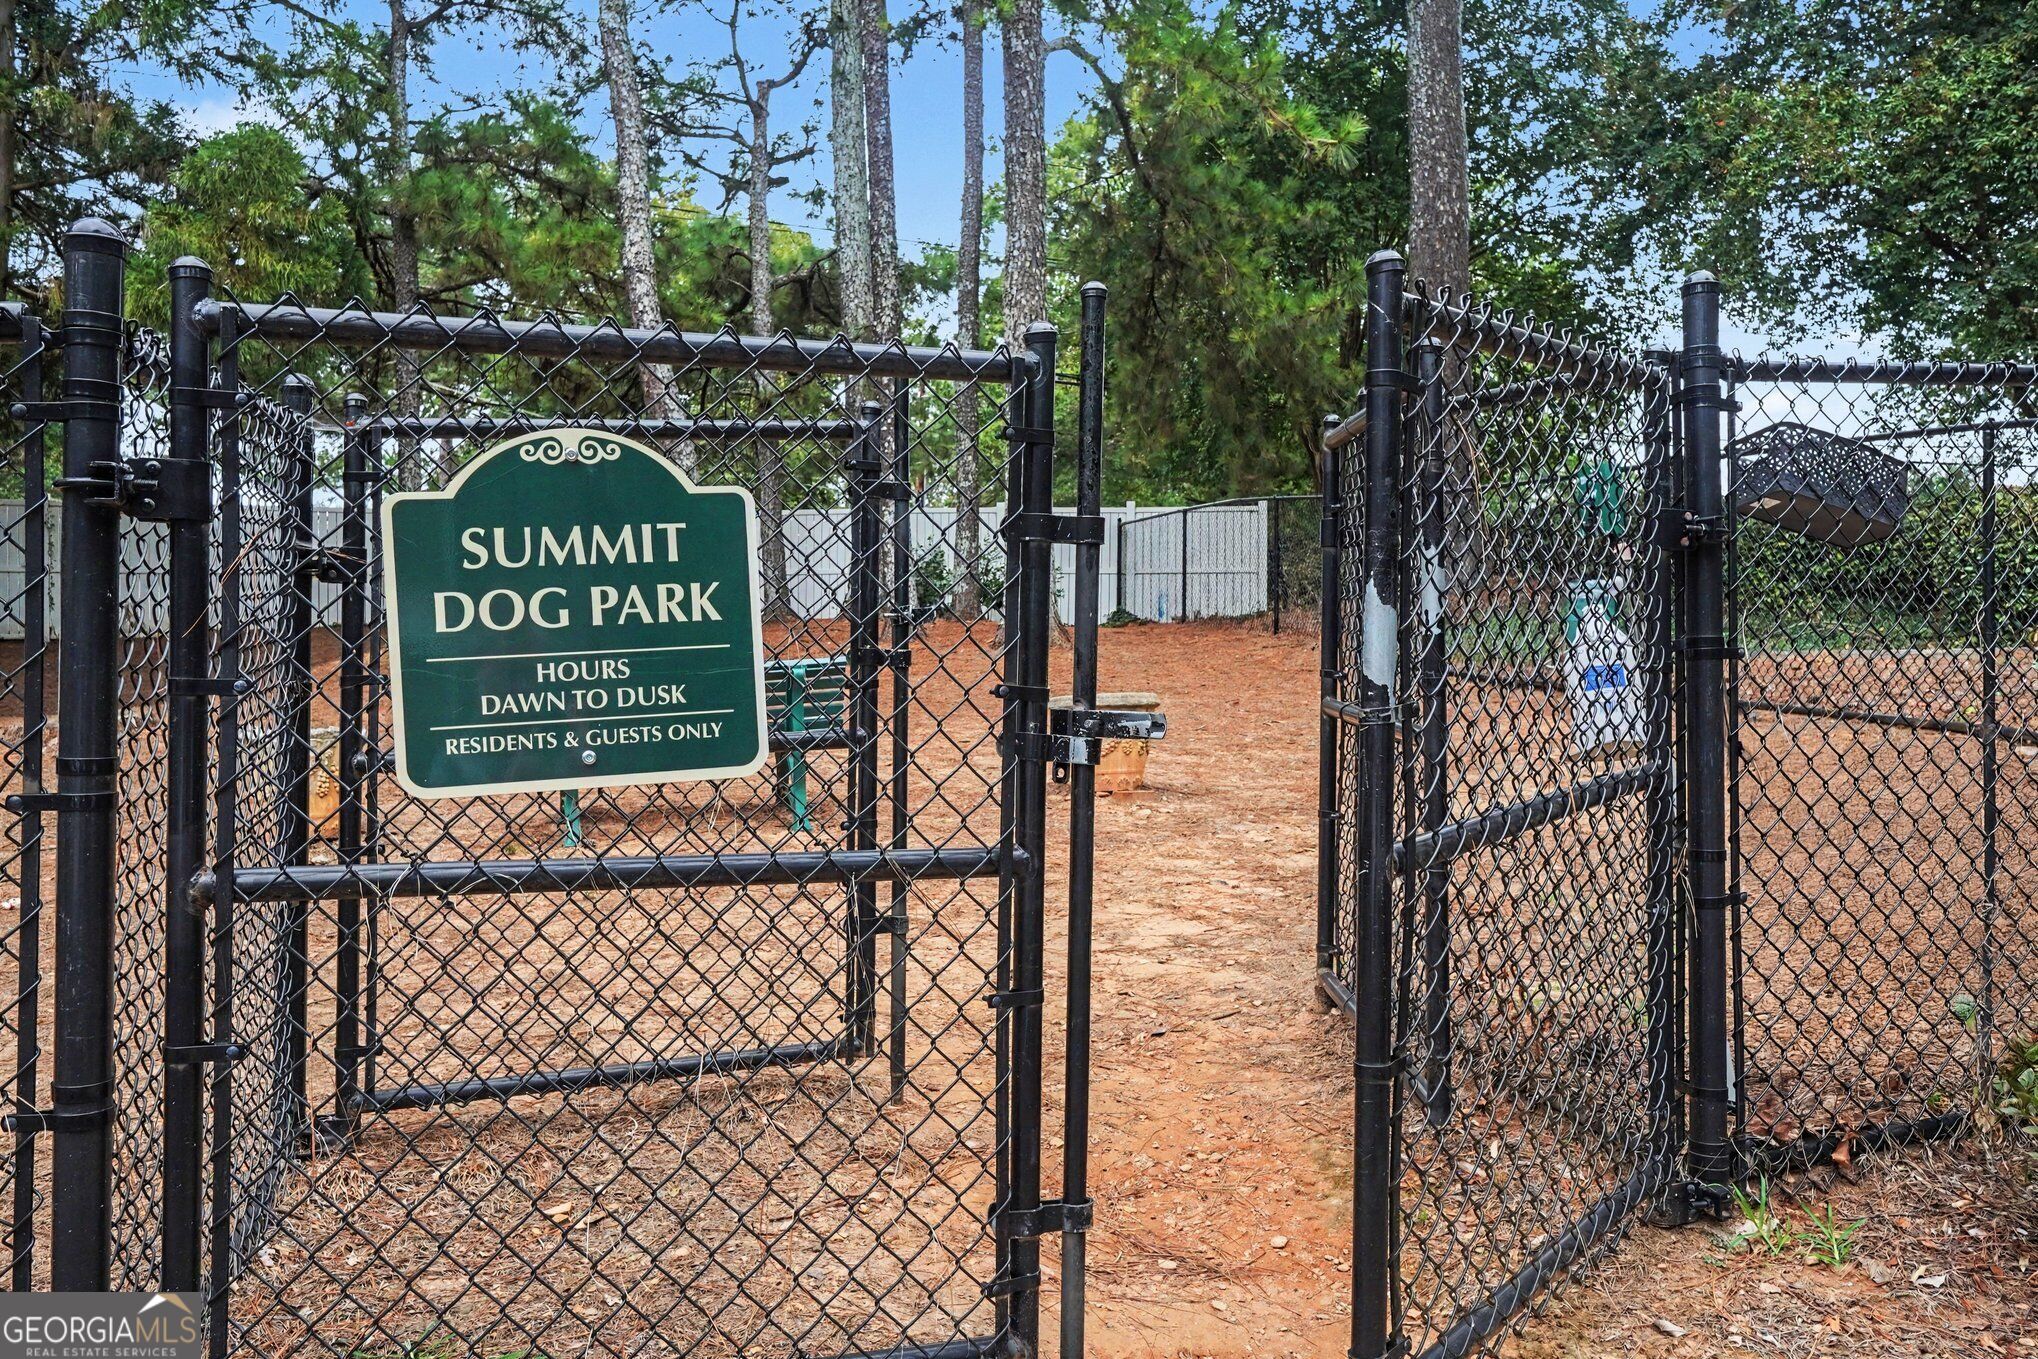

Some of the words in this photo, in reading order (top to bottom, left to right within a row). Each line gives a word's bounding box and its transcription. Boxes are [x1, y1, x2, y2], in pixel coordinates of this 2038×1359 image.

[460, 522, 687, 570] SUMMIT
[433, 586, 570, 633] DOG
[590, 581, 723, 626] PARK
[536, 658, 631, 683] HOURS
[481, 691, 566, 715] DAWN
[571, 688, 608, 710] TO
[617, 684, 687, 708] DUSK
[445, 732, 558, 755] RESIDENTS
[564, 730, 580, 748] &
[585, 724, 662, 746] GUESTS
[668, 722, 723, 742] ONLY
